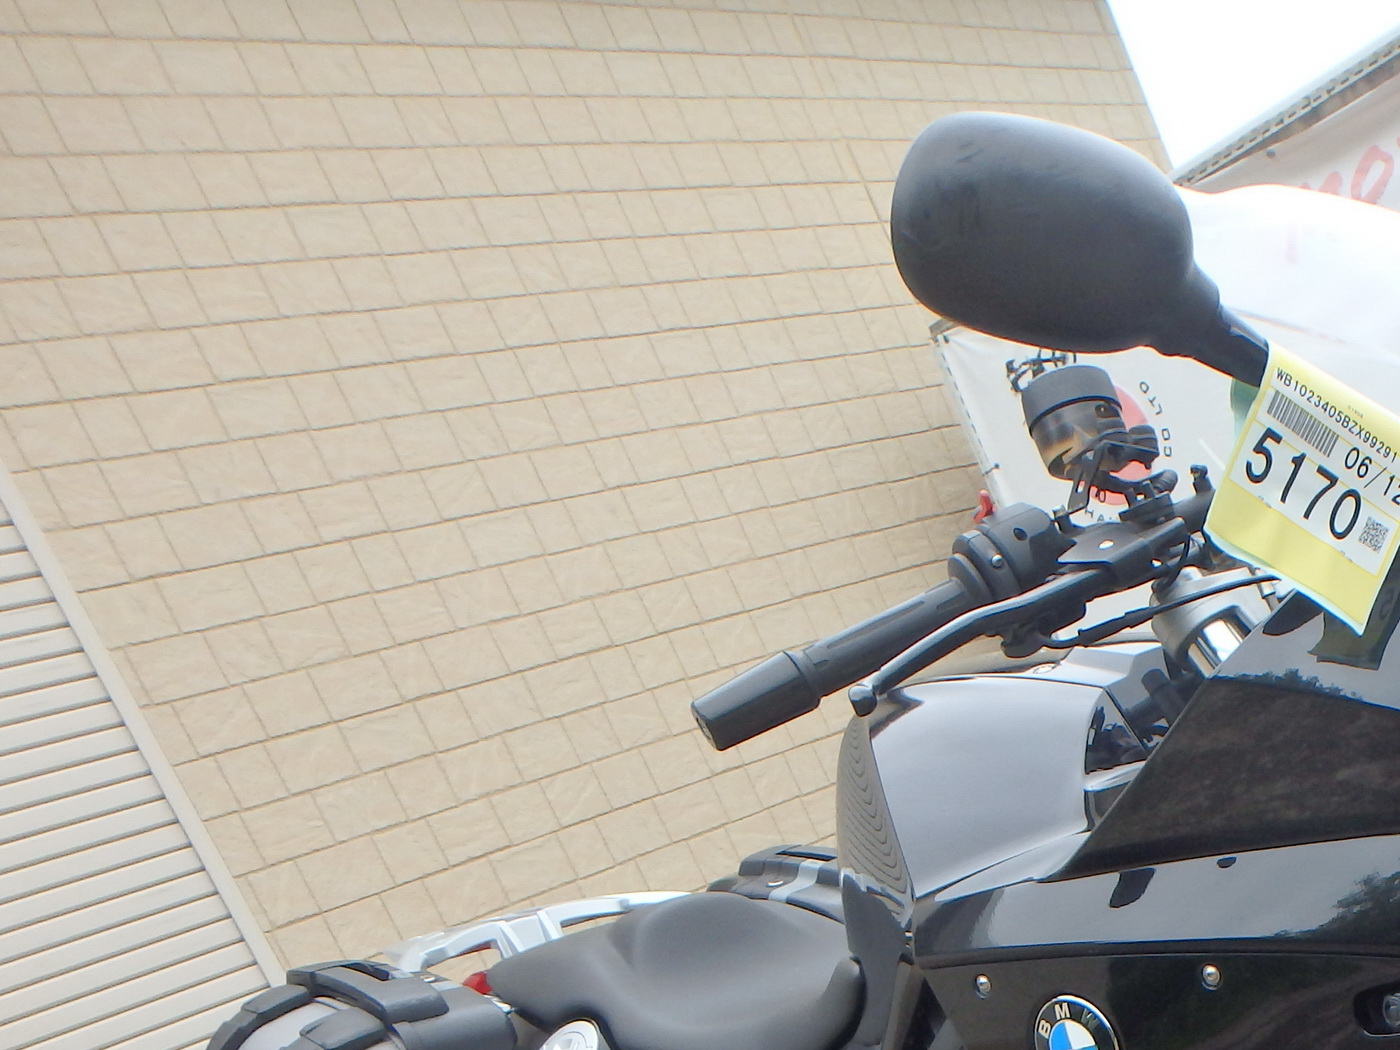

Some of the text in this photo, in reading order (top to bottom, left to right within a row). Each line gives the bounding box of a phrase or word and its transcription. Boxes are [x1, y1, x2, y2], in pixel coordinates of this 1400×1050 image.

[1275, 367, 1398, 464] WB1023405BZX99291
[1245, 427, 1363, 541] 5170
[1037, 1002, 1100, 1040] BMW
